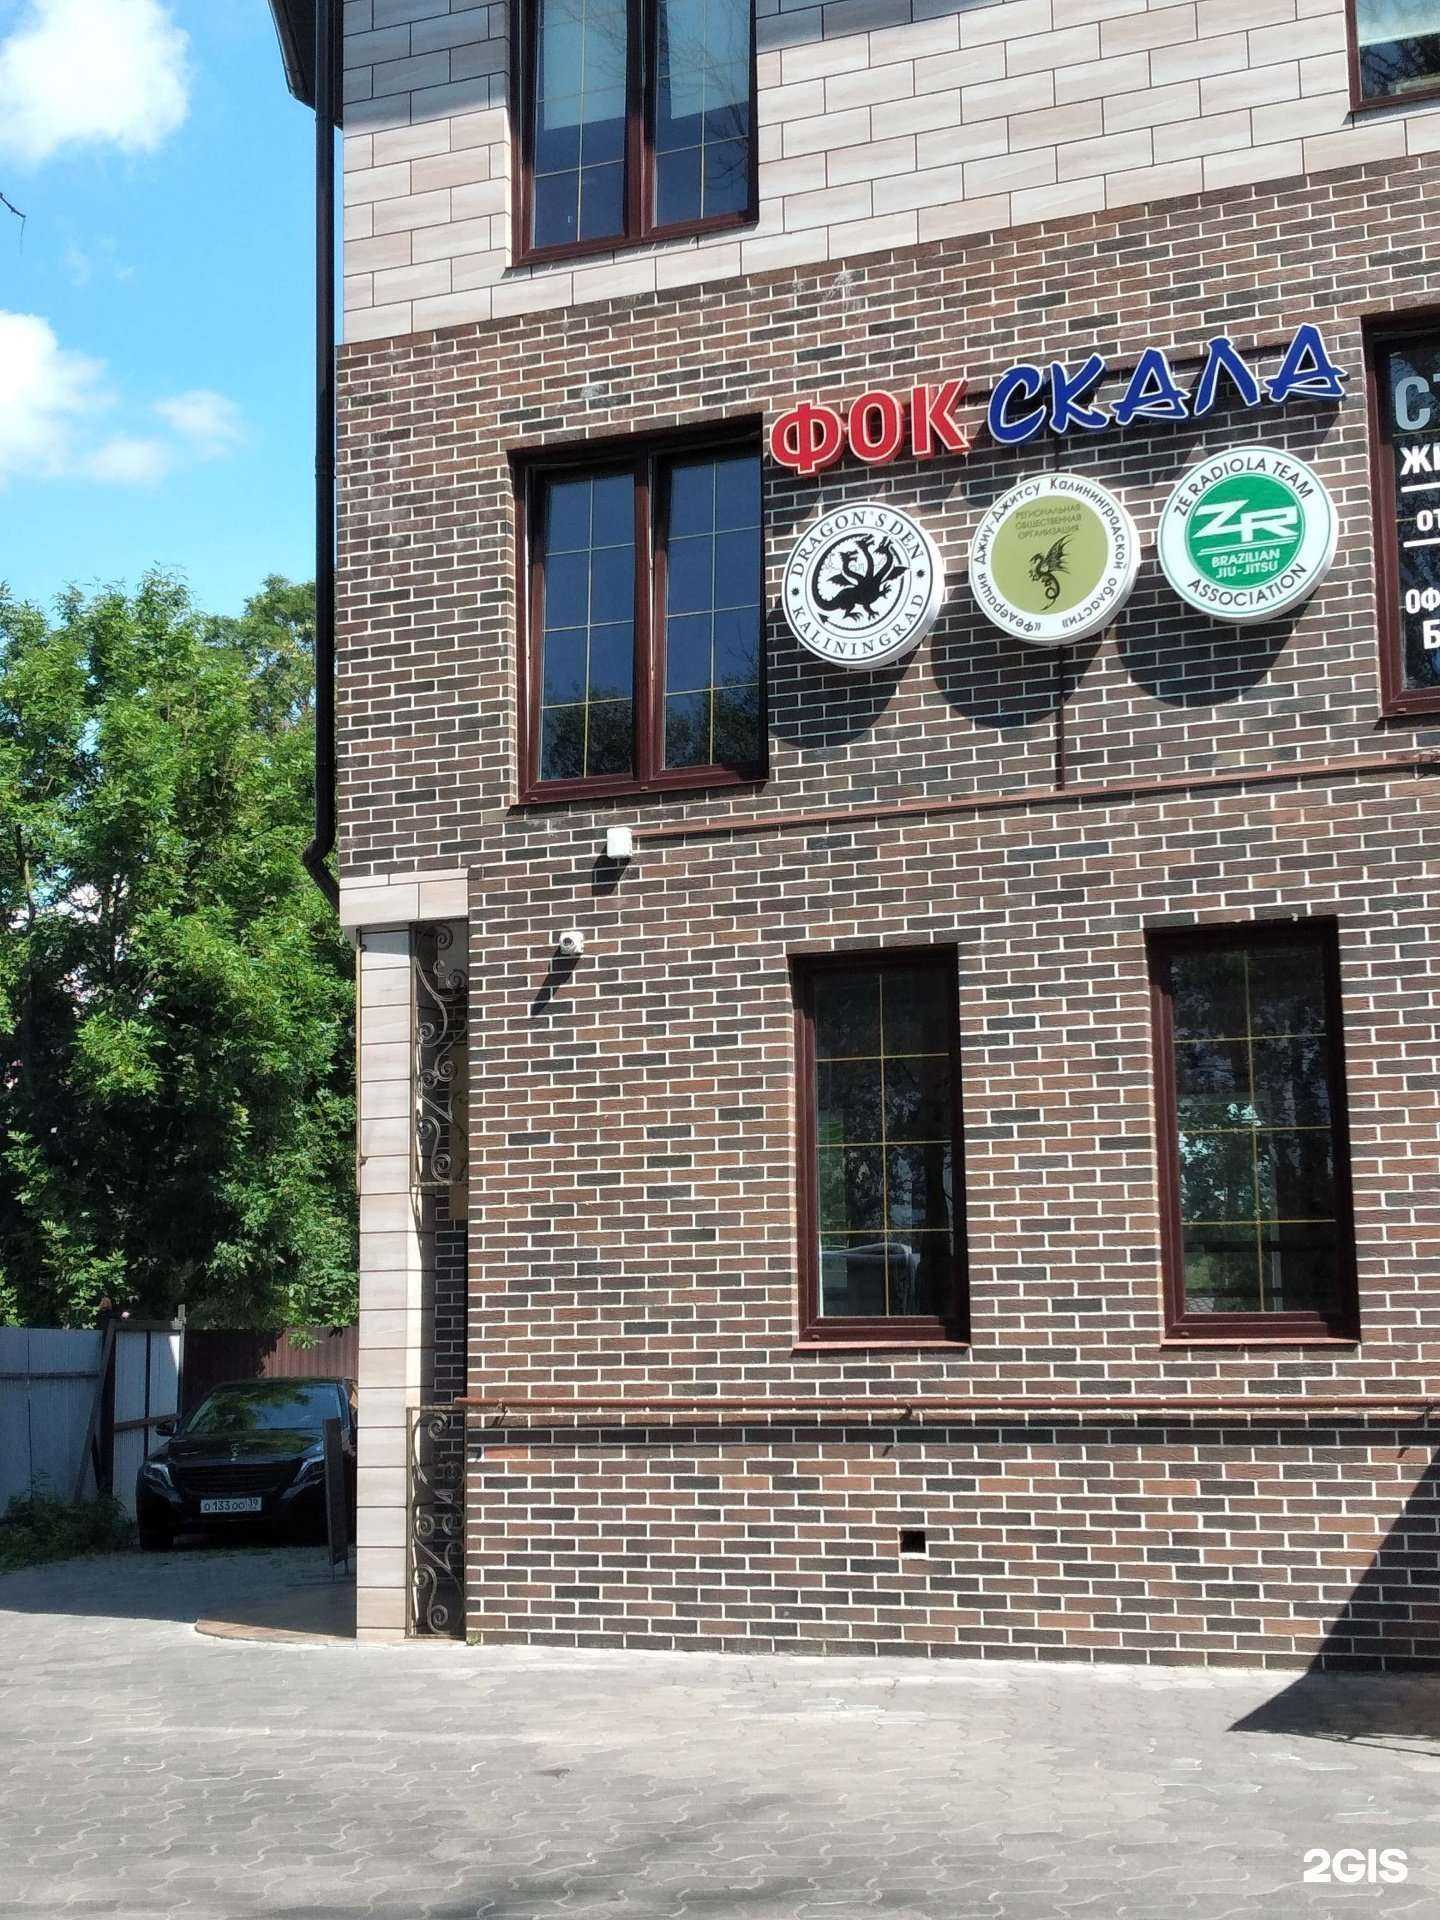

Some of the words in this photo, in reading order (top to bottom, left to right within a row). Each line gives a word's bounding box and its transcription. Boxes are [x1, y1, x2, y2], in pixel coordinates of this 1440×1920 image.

[770, 378, 968, 475] ФОК
[987, 323, 1348, 443] СКАЛА
[1395, 373, 1440, 430] С
[1188, 457, 1266, 495] RADIOLA
[1272, 461, 1314, 499] TEAM
[888, 520, 924, 560] DEN
[1192, 499, 1299, 542] ZR
[1211, 548, 1281, 567] BRAZILIAN
[1215, 561, 1279, 579] JIU-JITSU
[1187, 563, 1307, 607] ASSOCIATION
[791, 594, 924, 656] KALININGRAD
